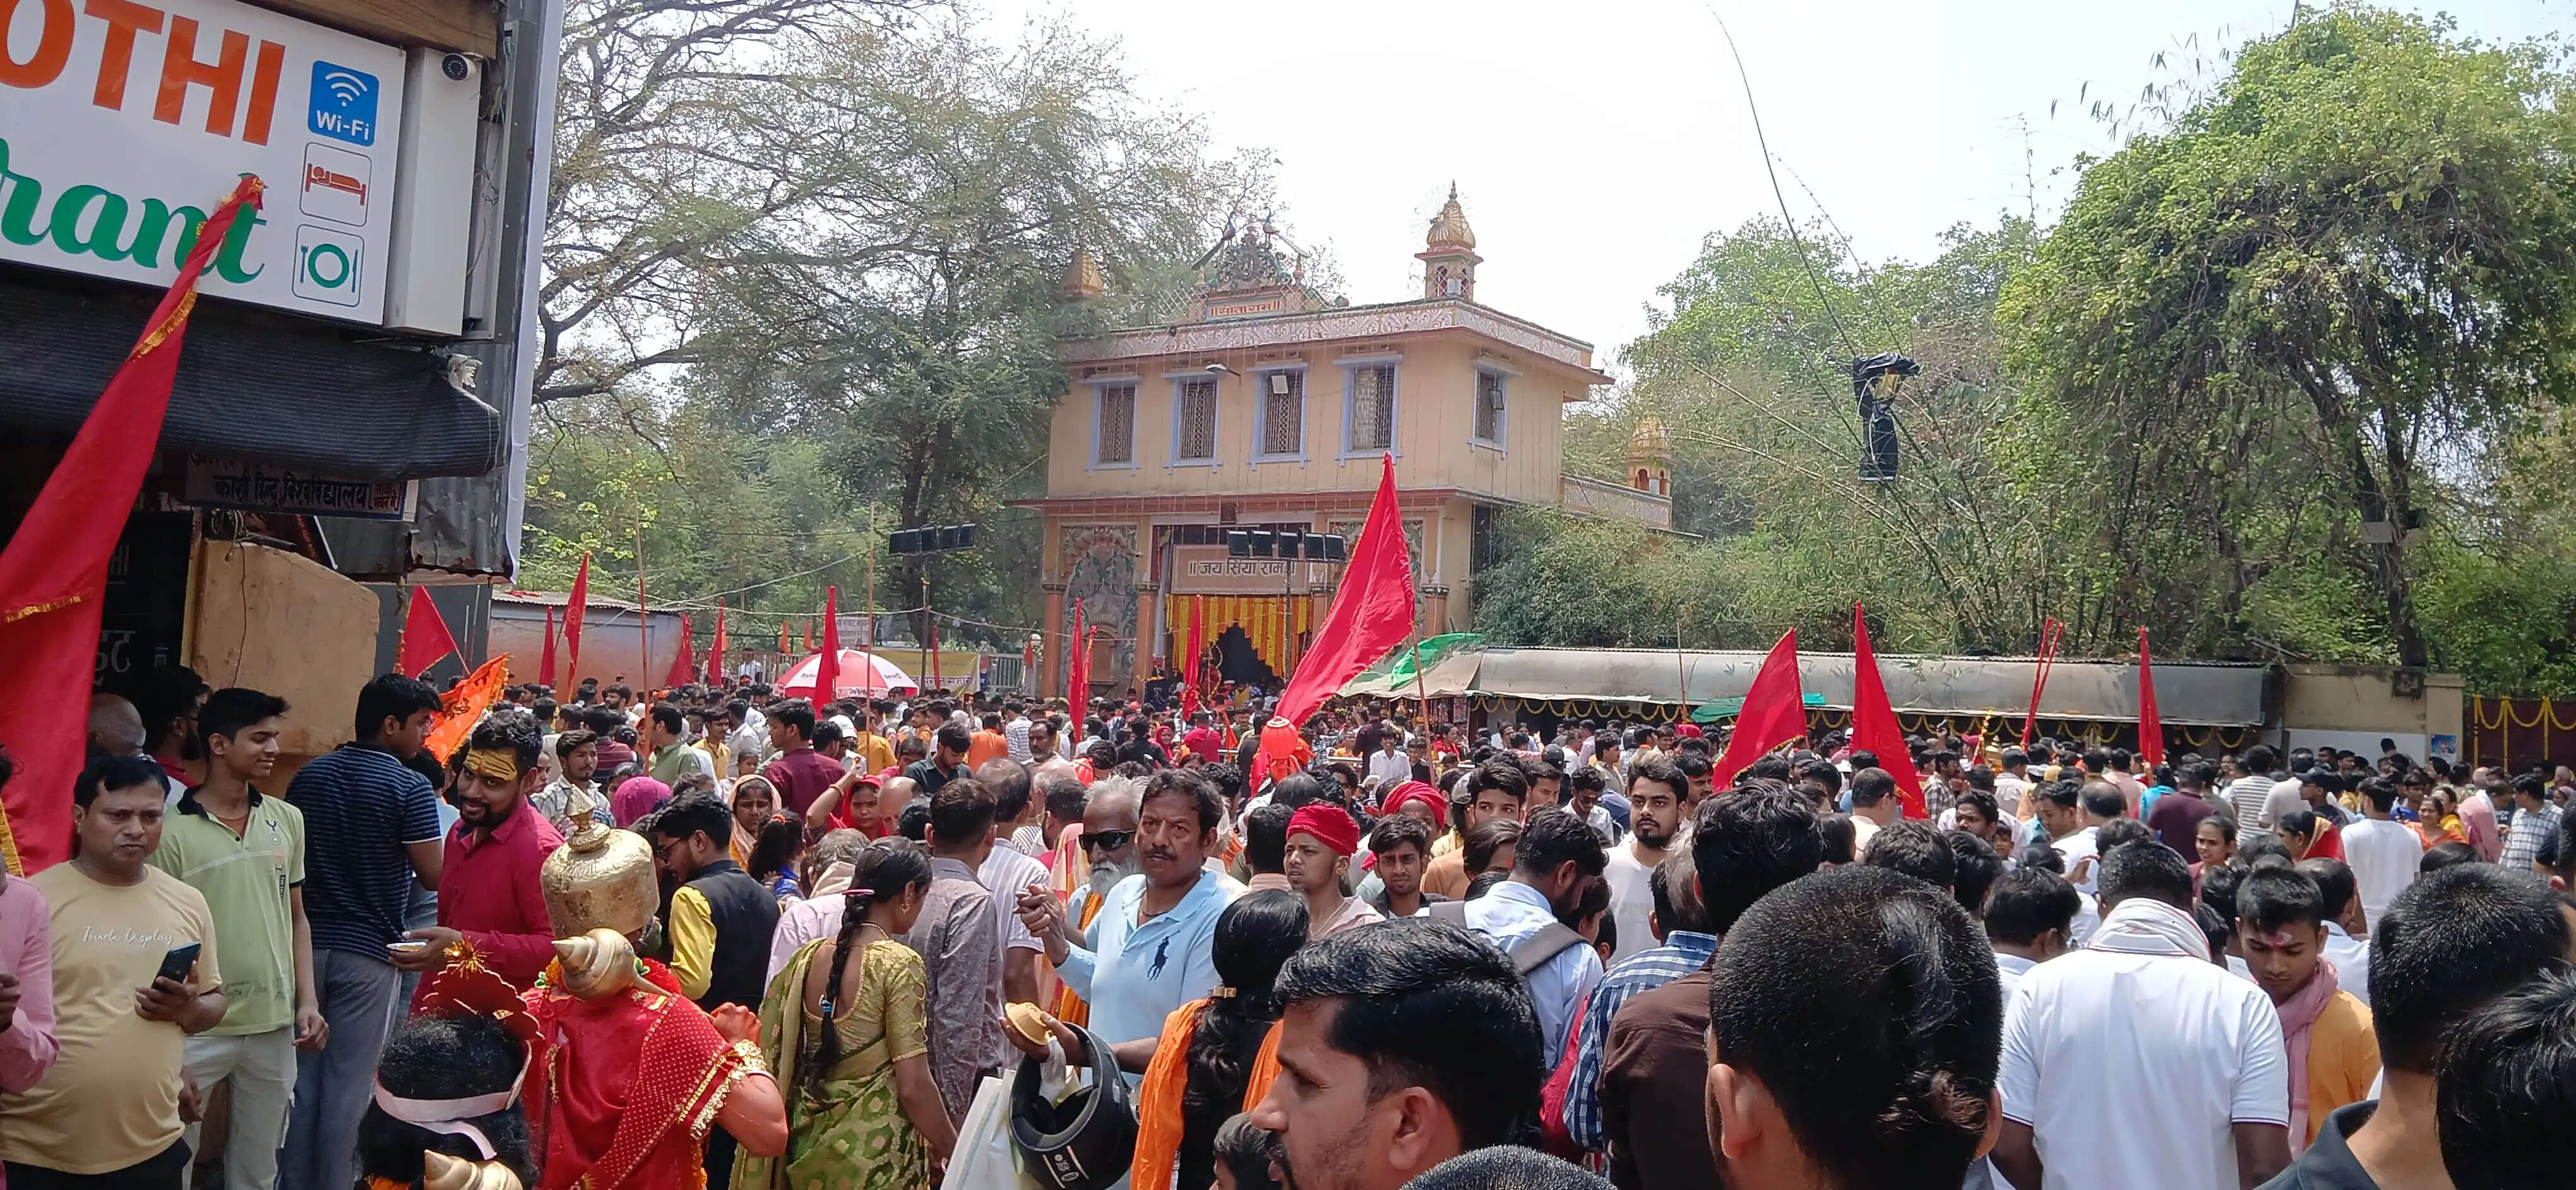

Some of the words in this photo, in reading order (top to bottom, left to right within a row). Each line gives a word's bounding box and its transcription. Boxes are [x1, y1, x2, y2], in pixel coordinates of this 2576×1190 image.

[316, 110, 370, 141] Wi-Fi
[1200, 562, 1223, 575] जय
[1260, 562, 1285, 575] राम
[126, 927, 172, 948] Display
